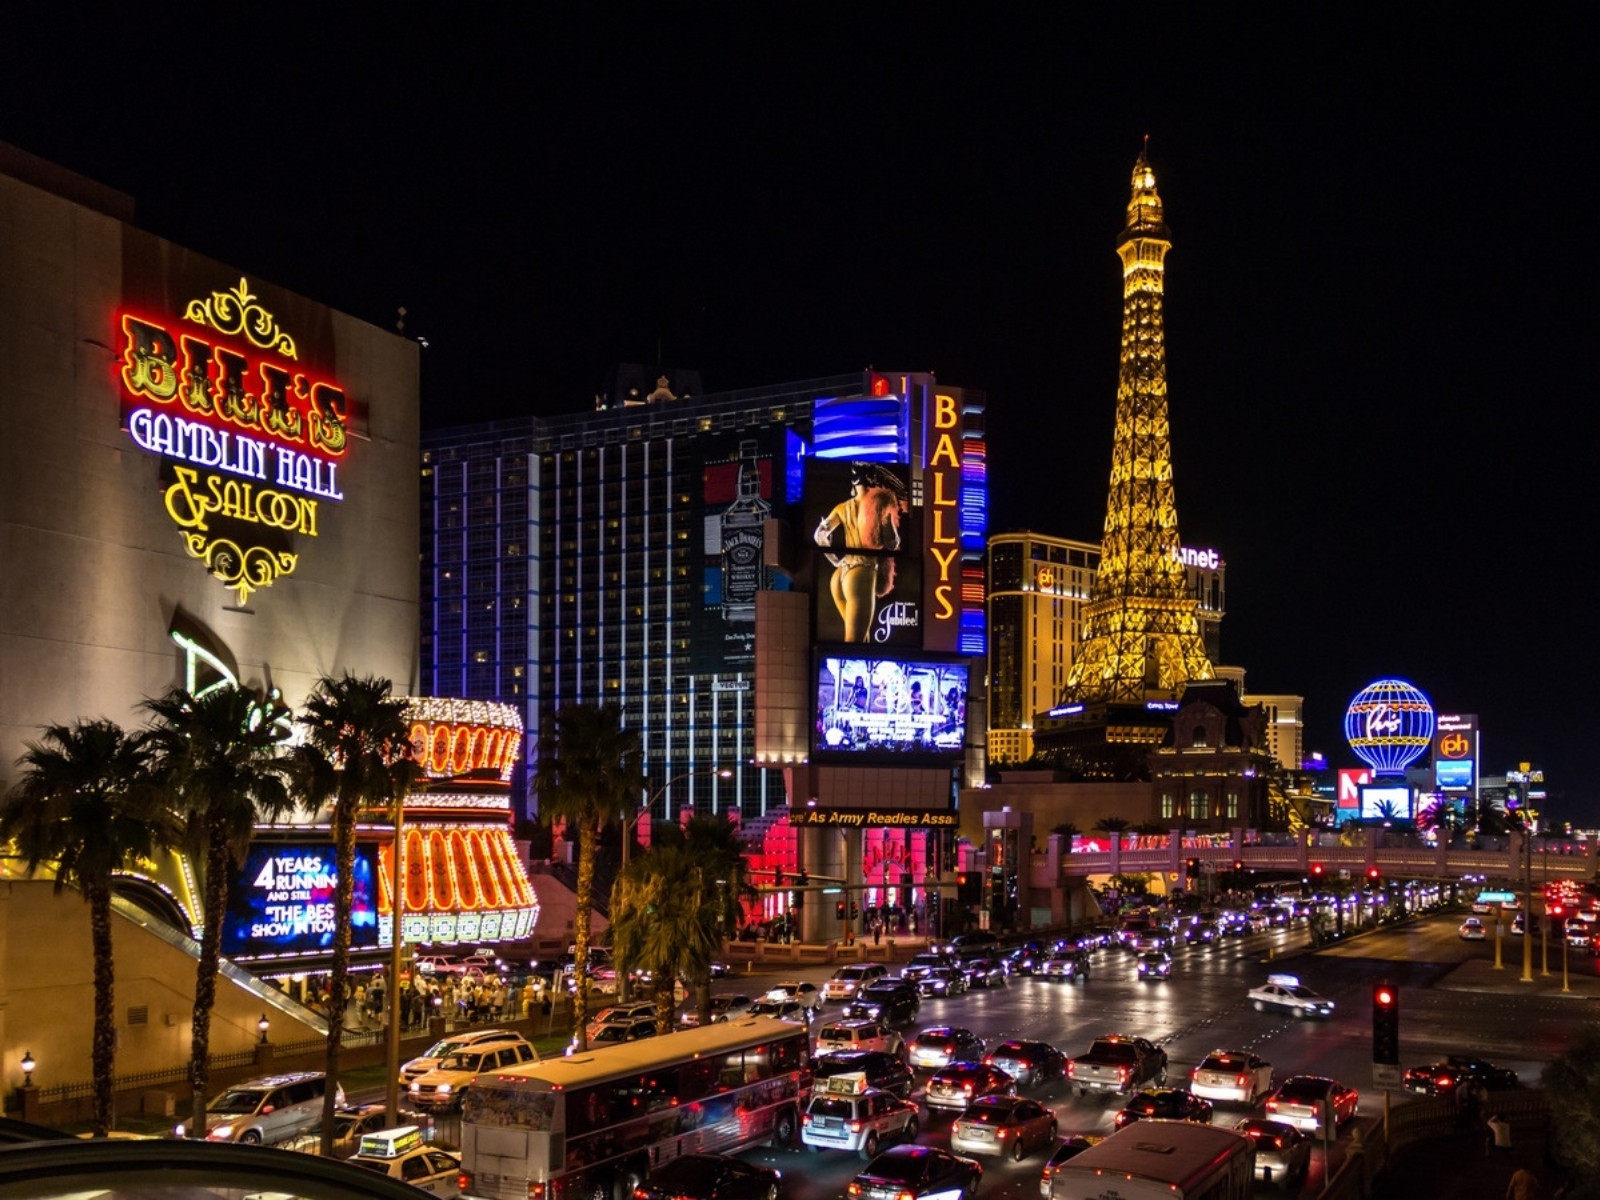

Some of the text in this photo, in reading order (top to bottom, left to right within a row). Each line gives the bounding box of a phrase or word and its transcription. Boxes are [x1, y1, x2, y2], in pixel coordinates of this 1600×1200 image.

[122, 314, 347, 456] BILL'S
[130, 408, 343, 500] GAMBLIN' HALL
[165, 465, 318, 537] & SALOON
[930, 394, 960, 620] BALLYS
[874, 601, 919, 643] Jubilee!
[1444, 734, 1469, 756] ph
[809, 812, 825, 824] As
[829, 812, 863, 826] Army
[867, 812, 918, 825] Readies
[253, 856, 321, 890] 4 YEARS
[276, 873, 338, 890] RUNNIN
[267, 890, 312, 902] AND STILL
[306, 903, 334, 920] BES
[251, 919, 336, 937] SHOW IN TOW
